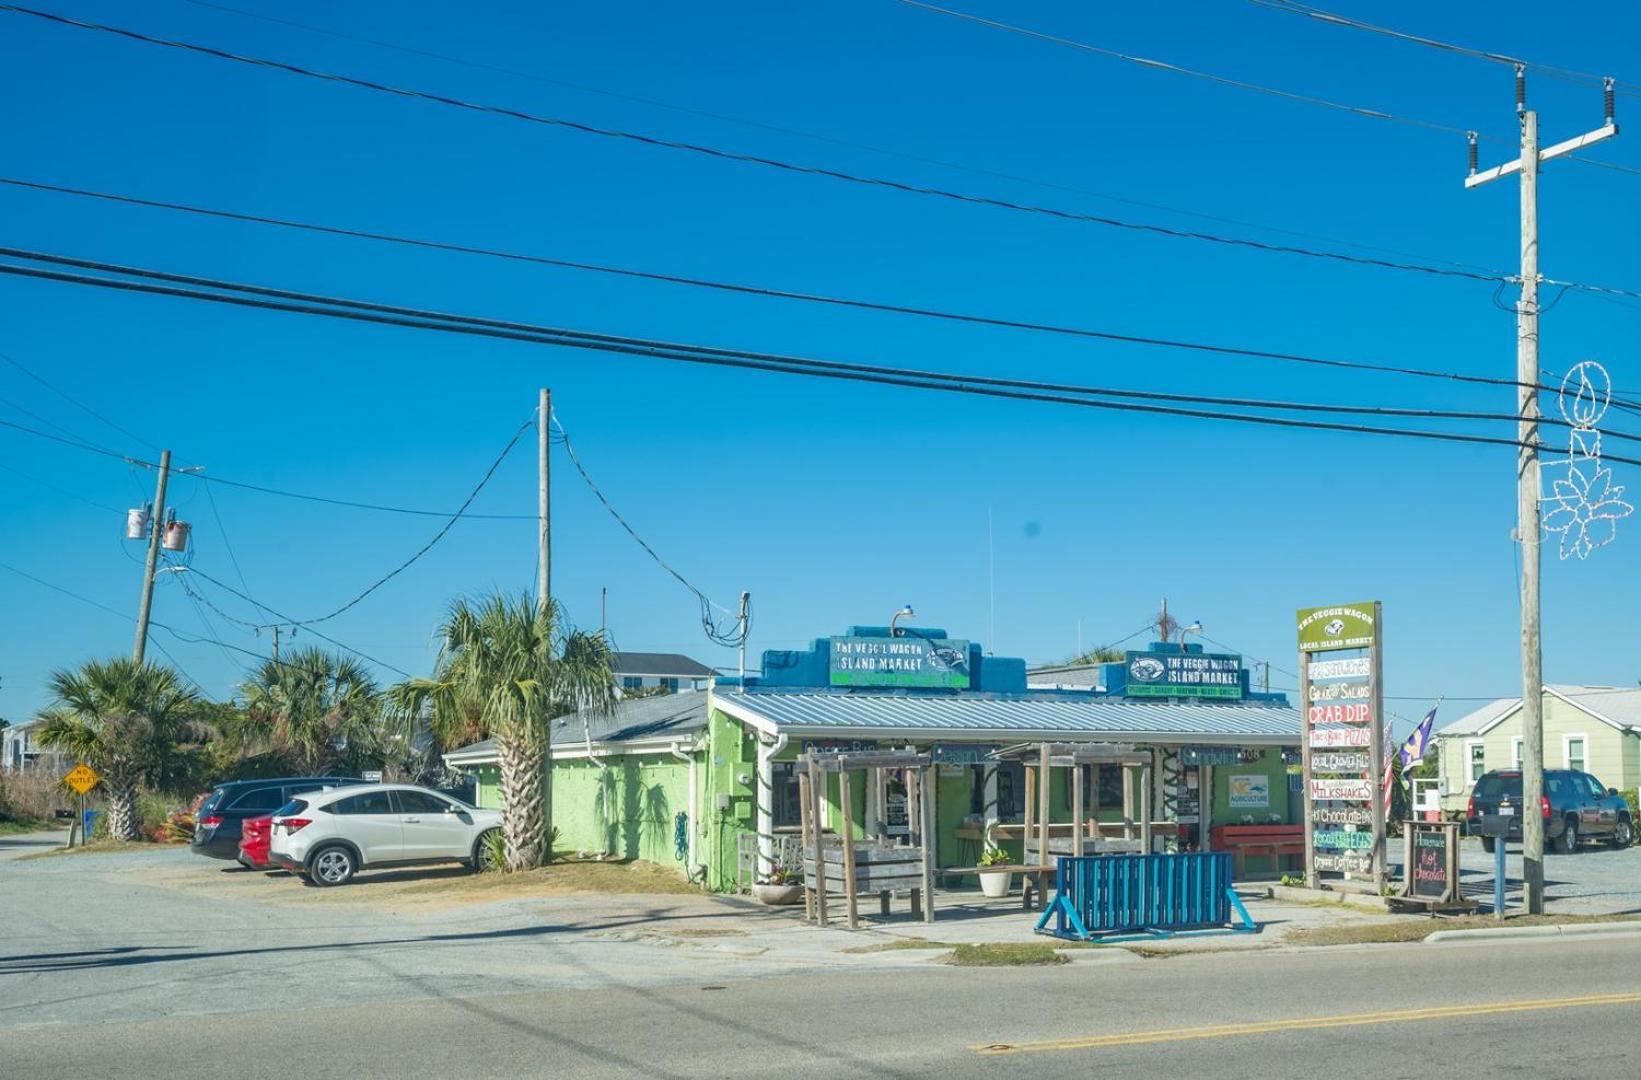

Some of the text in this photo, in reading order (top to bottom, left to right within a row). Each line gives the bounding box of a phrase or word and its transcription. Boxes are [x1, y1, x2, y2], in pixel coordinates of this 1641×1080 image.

[1298, 608, 1374, 630] THE VEGGIE WAGON
[888, 644, 922, 654] WAGON
[1300, 637, 1373, 650] LOCAL ISLAND MARKET
[837, 657, 922, 671] ISLAND MARKET
[1167, 658, 1238, 670] THE VEGGIE WAGON
[1168, 671, 1238, 684] ISLAND MARKET
[1309, 704, 1369, 724] CRAB DIP
[1312, 780, 1371, 799] MILKSHAKES
